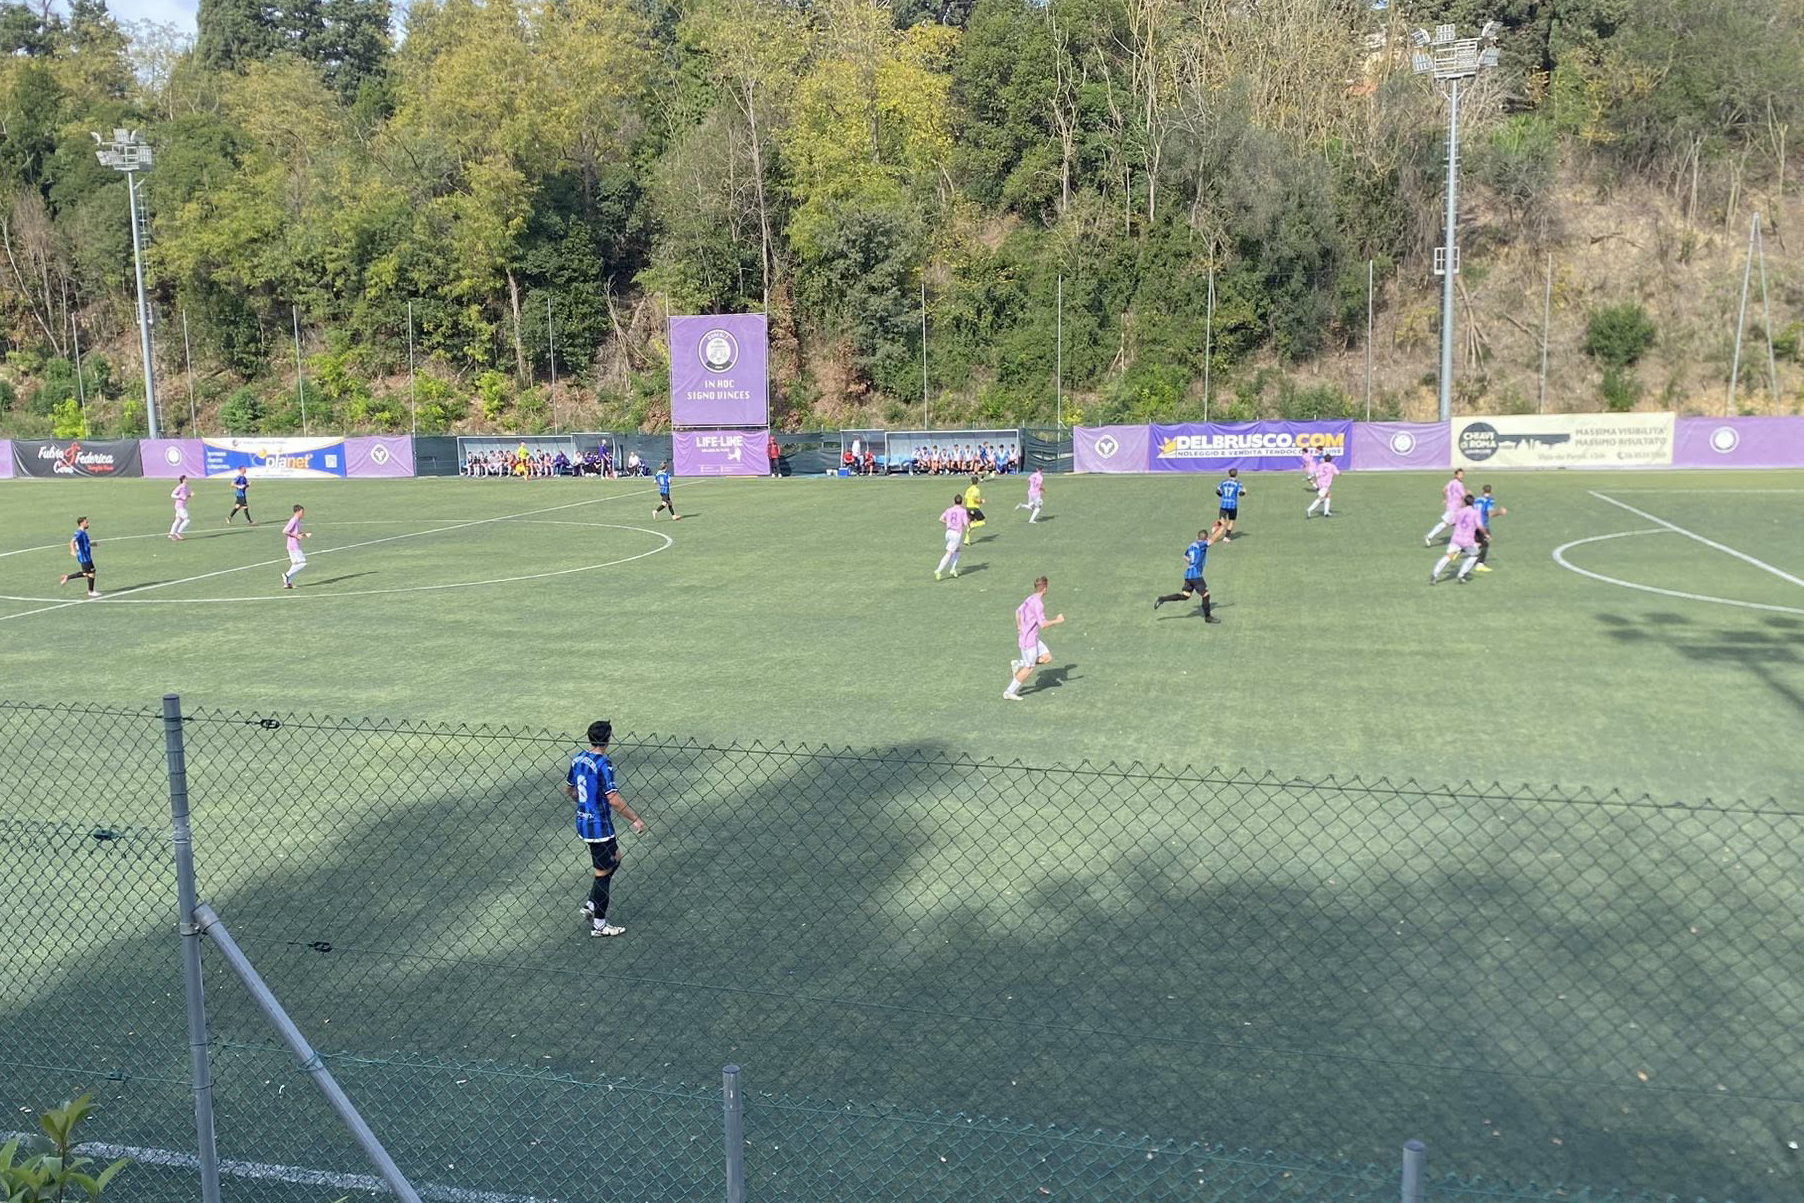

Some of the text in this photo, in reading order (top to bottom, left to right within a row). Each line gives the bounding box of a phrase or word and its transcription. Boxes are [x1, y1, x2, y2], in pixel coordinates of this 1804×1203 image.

[704, 379, 735, 388] IN HOC
[687, 391, 715, 400] SIGNO
[1575, 428, 1617, 436] MASSIMA
[1176, 432, 1345, 449] DELBRUSCO.COM
[1469, 440, 1497, 448] ROMA
[1575, 438, 1617, 446] MASSIMO
[75, 451, 114, 464] Federica
[266, 453, 309, 469] planet
[1223, 487, 1234, 497] 17
[950, 513, 958, 526] 8
[1461, 514, 1469, 529] 6
